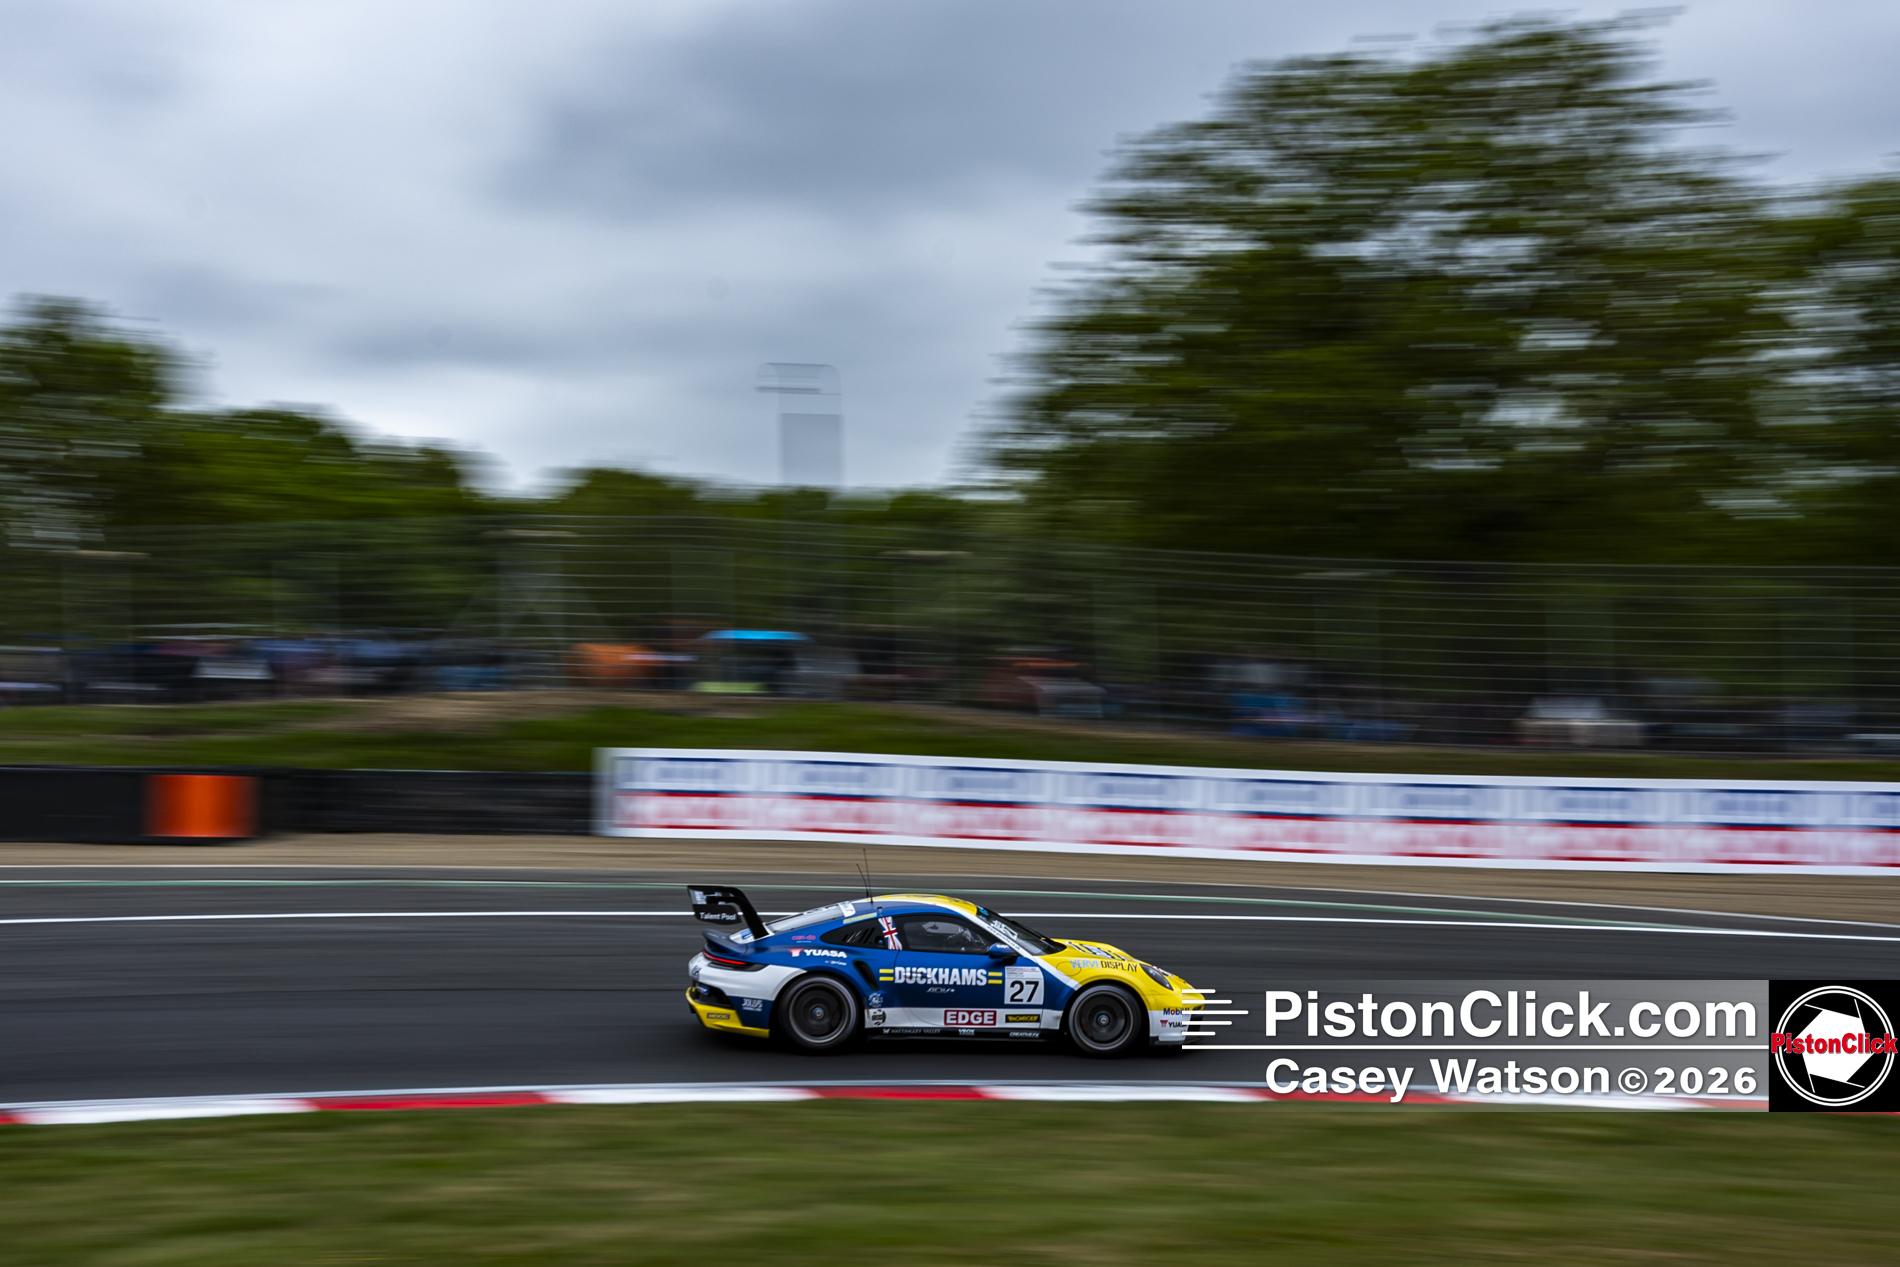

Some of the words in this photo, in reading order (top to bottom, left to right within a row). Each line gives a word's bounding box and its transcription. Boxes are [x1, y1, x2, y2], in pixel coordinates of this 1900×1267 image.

[700, 912, 720, 920] Talent
[803, 949, 848, 959] YUASA
[894, 967, 988, 986] DUCKHAMS
[1009, 980, 1040, 1003] 27
[946, 1011, 995, 1025] EDGE
